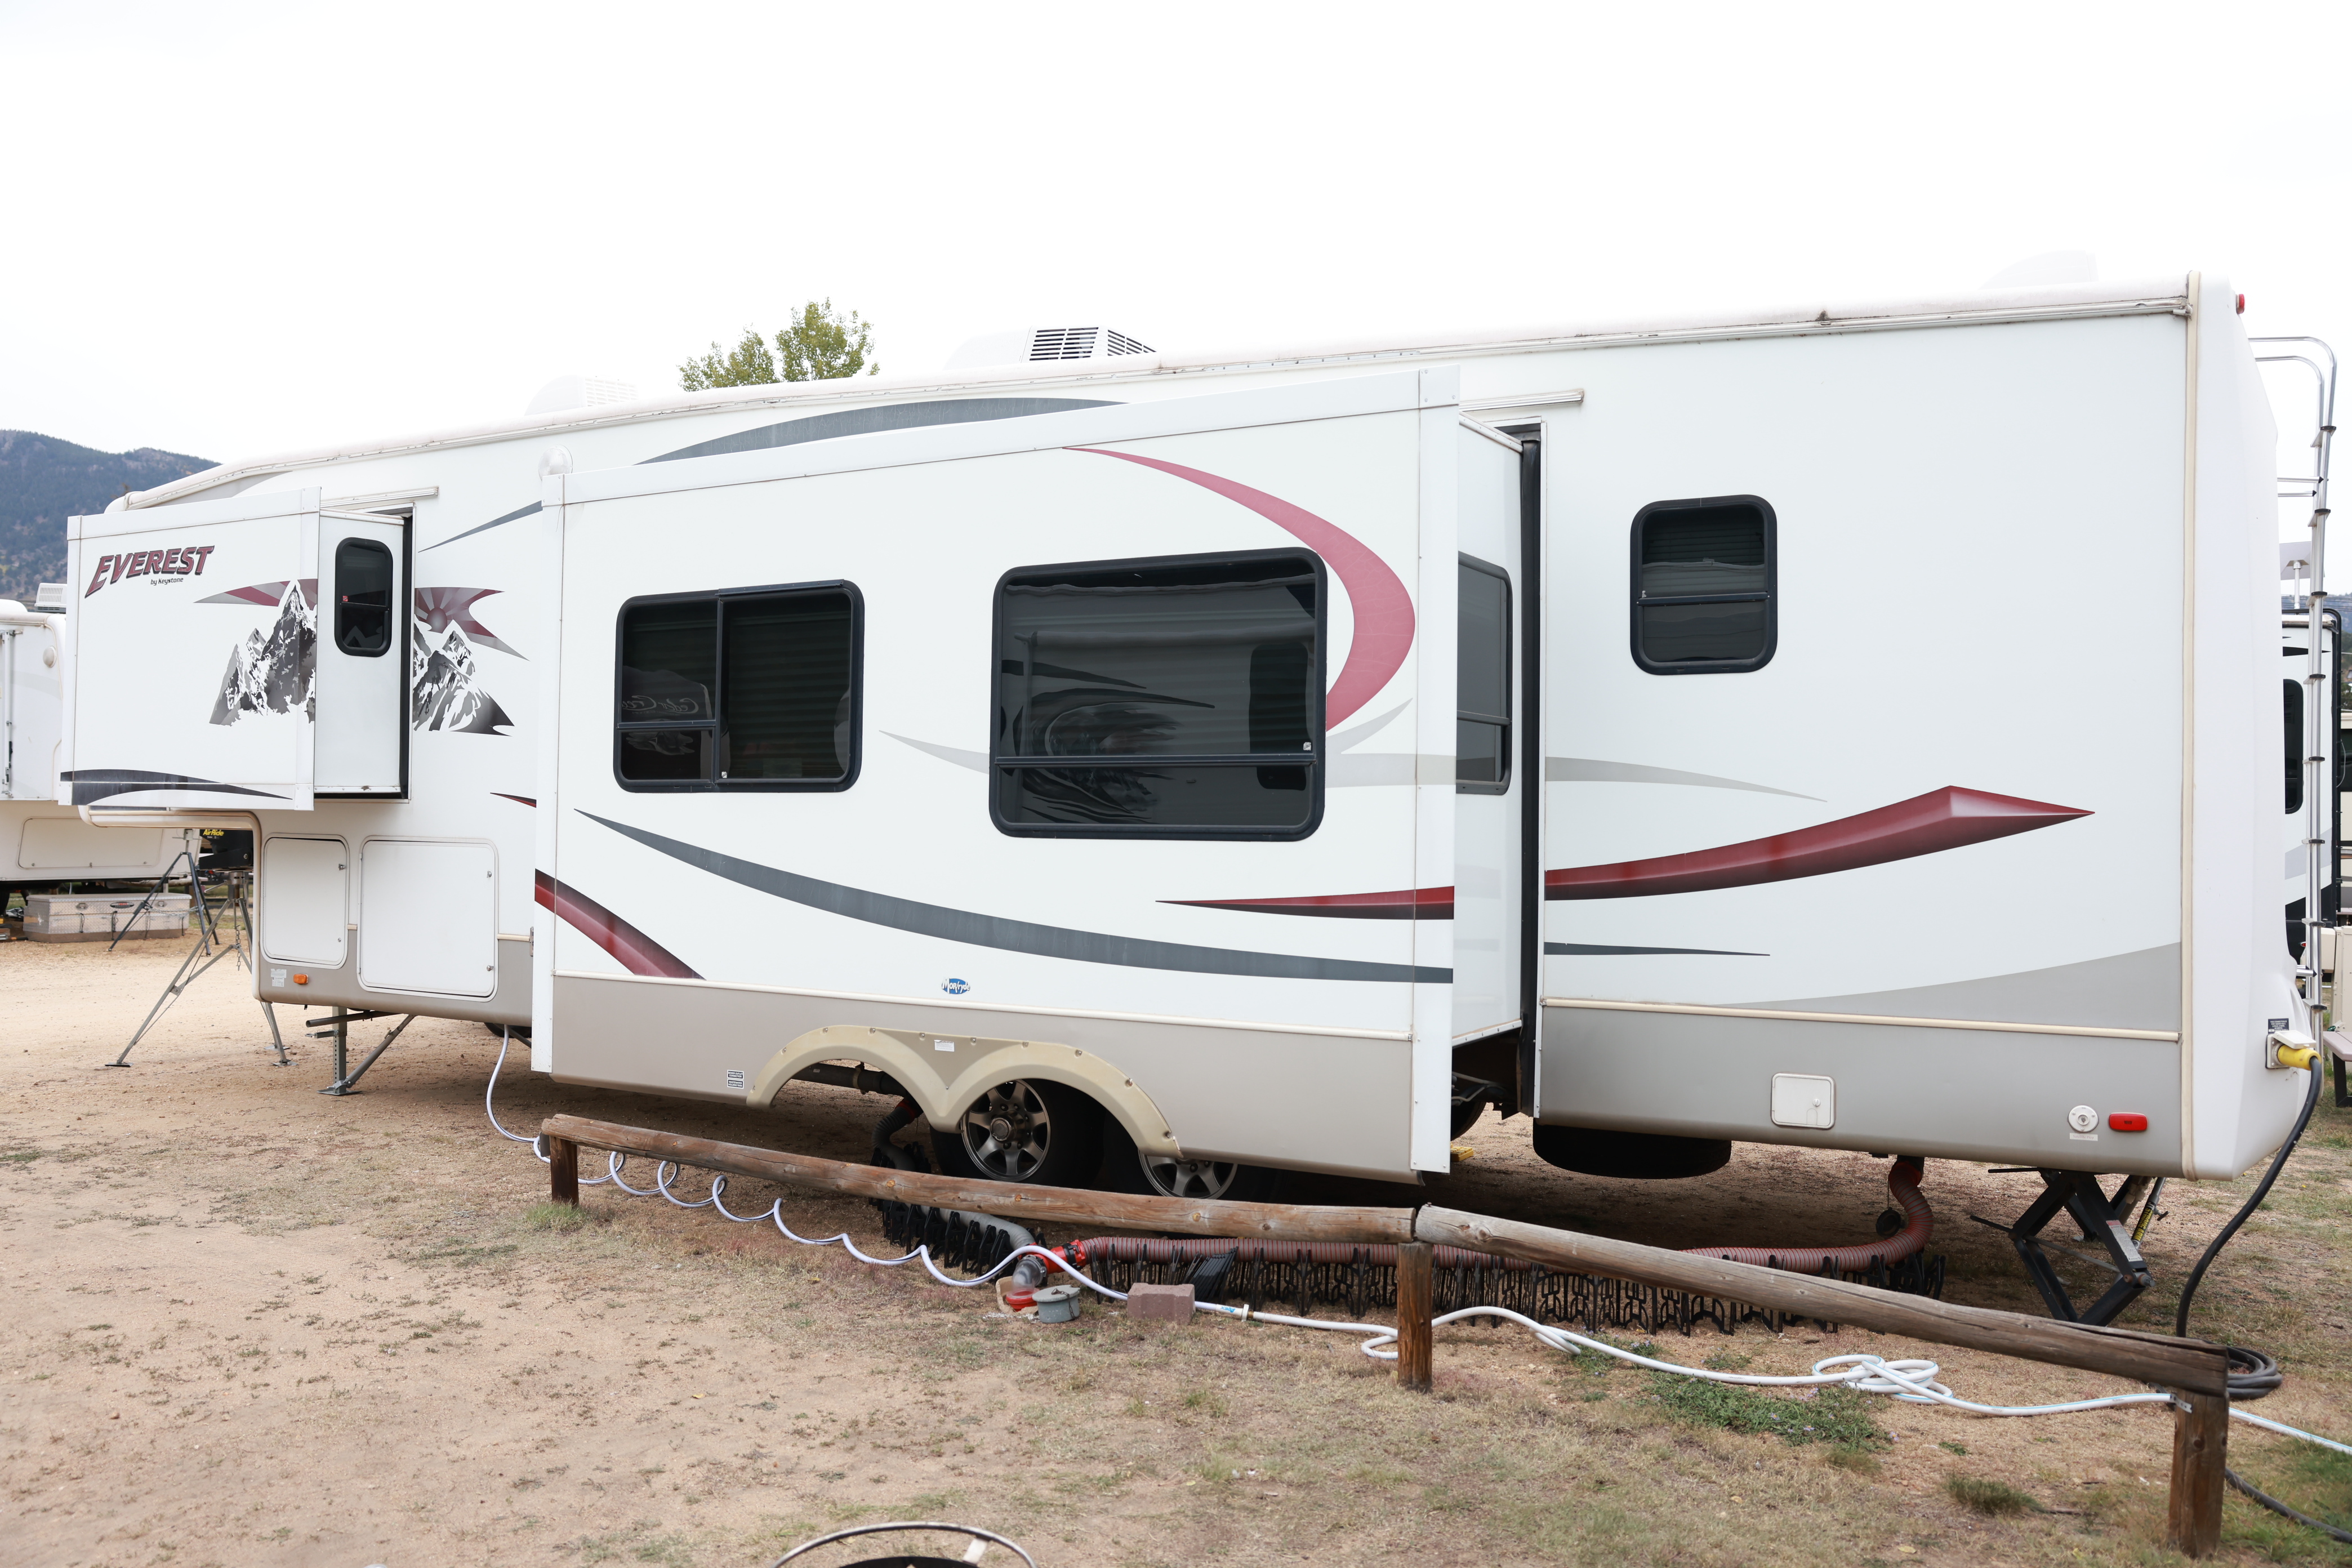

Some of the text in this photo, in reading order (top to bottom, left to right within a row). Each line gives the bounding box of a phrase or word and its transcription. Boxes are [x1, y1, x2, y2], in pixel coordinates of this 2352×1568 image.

[84, 545, 215, 599] EVEREST
[2140, 1208, 2153, 1230] STRONG
[2133, 1228, 2145, 1241] ARM
